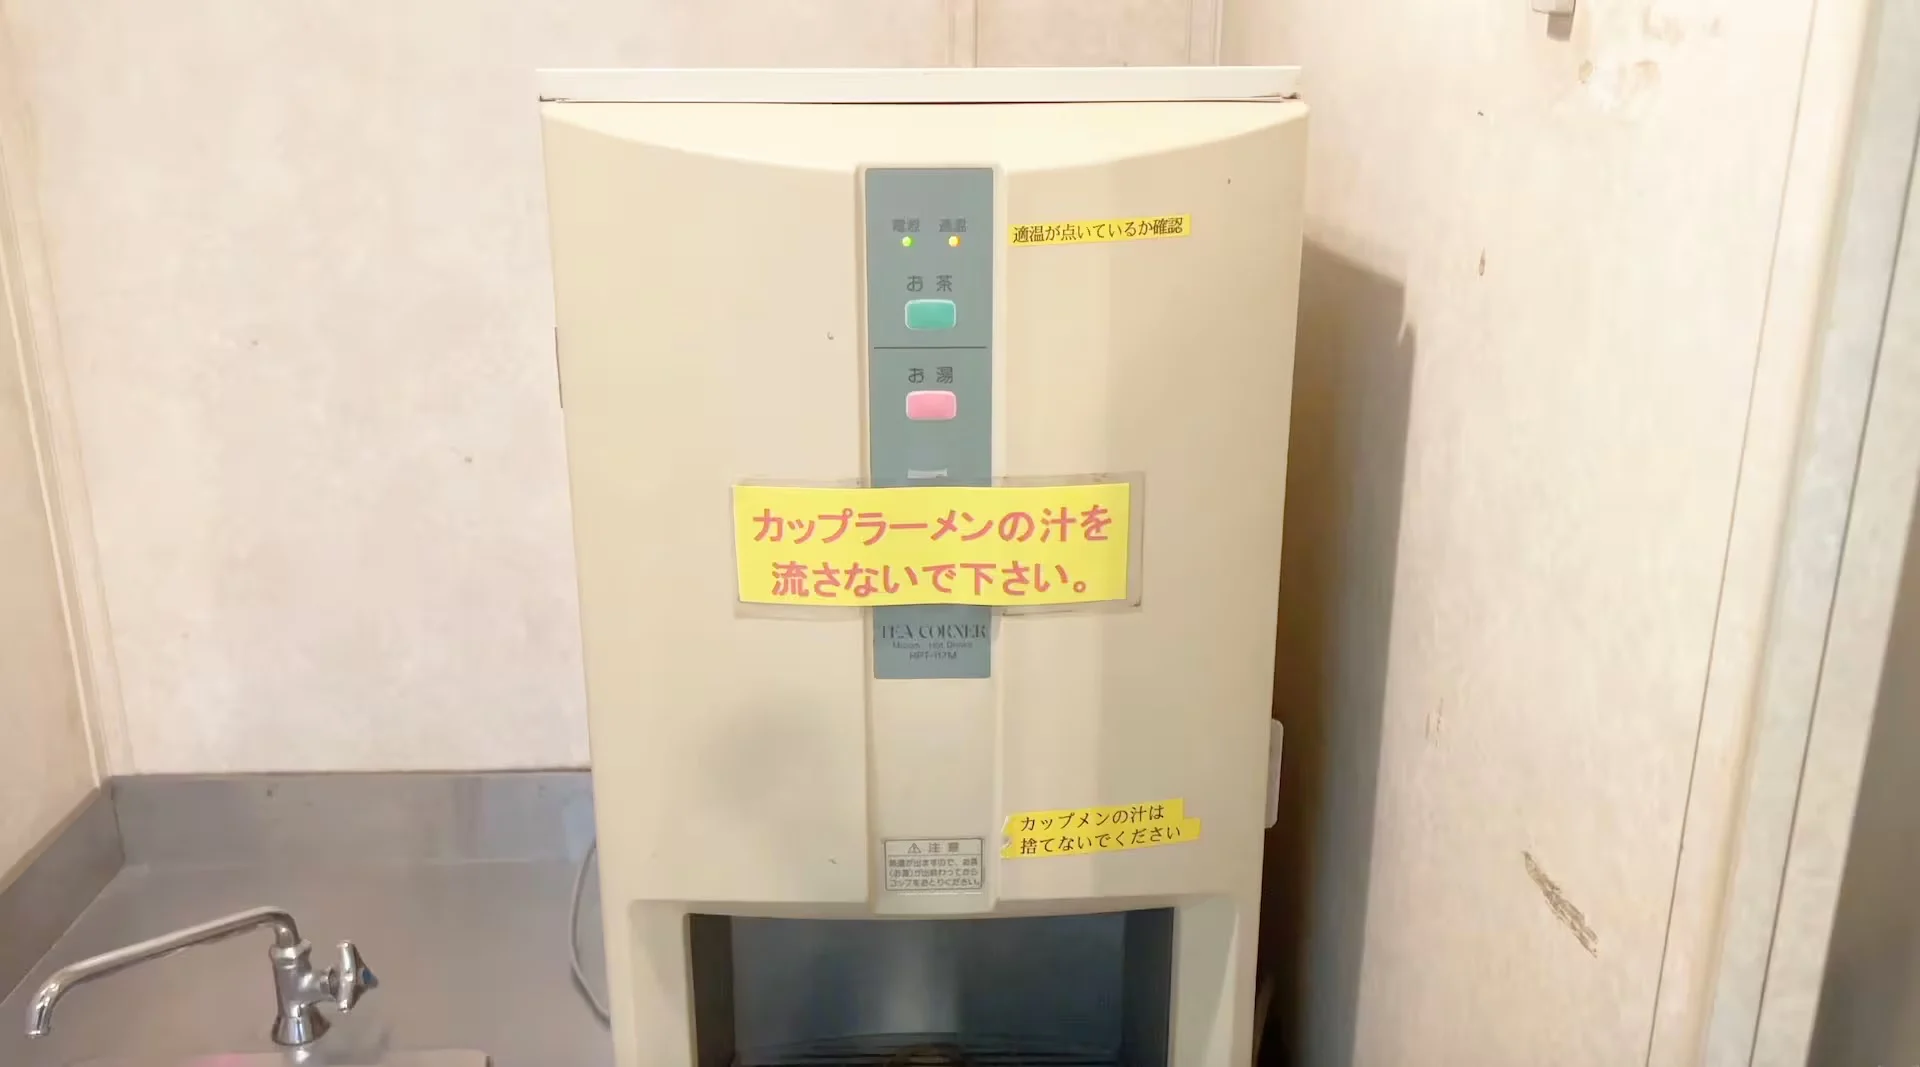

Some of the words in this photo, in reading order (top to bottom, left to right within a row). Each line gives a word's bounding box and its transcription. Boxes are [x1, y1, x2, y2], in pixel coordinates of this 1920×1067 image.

[1013, 217, 1183, 243] 適温が点いているか確認
[906, 275, 953, 292] お茶
[908, 366, 953, 384] お湯
[753, 504, 1113, 545] カップラーメンの汁を
[771, 560, 1087, 598] 流さないで下さい。
[882, 624, 914, 639] TEA
[918, 624, 987, 639] CORNER
[1020, 805, 1165, 832] カップメンの汁は
[1020, 825, 1182, 855] 捨てないでください
